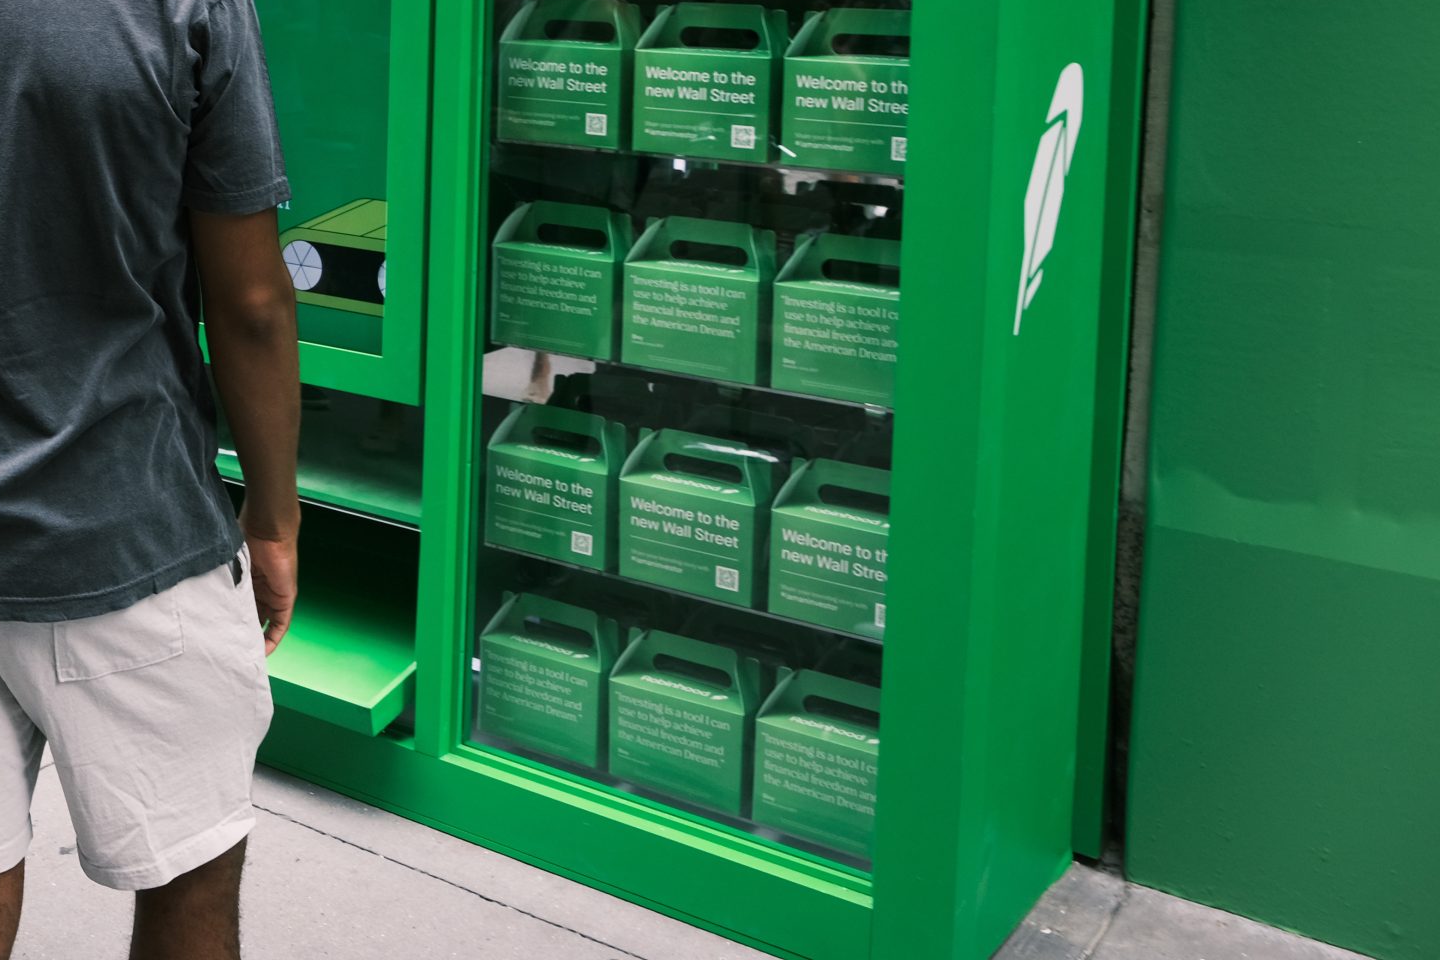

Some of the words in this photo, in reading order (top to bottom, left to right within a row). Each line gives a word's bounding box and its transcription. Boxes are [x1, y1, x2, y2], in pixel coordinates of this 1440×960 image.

[508, 56, 566, 73] Welcome
[569, 61, 583, 74] to
[585, 62, 608, 76] the
[645, 65, 710, 83] Welcome
[712, 70, 728, 84] to
[731, 72, 756, 86] the
[508, 77, 534, 88] new
[536, 76, 564, 90] Wall
[566, 78, 608, 93] Street
[796, 75, 868, 93] Welcome
[871, 80, 888, 94] to
[644, 87, 674, 98] new
[677, 86, 706, 101] Wall
[710, 88, 756, 104] Street
[796, 97, 828, 109] new
[832, 96, 864, 112] Wall
[680, 281, 688, 291] is
[698, 284, 720, 295] tool
[726, 289, 746, 298] can
[633, 291, 651, 300] use
[652, 291, 664, 301] to
[664, 293, 687, 307] help
[688, 297, 728, 310] achieve
[633, 301, 674, 315] financial
[676, 307, 718, 322] freedom
[720, 315, 740, 325] and
[633, 314, 648, 325] the
[650, 317, 698, 332] American
[496, 464, 552, 489] Welcome
[555, 478, 568, 493] to
[570, 482, 593, 499] the
[496, 483, 522, 498] new
[524, 487, 550, 505] Wall
[552, 494, 592, 515] Street
[630, 495, 694, 521] Welcome
[698, 510, 712, 525] to
[715, 514, 740, 531] the
[630, 516, 660, 531] new
[662, 520, 692, 538] Wall
[694, 527, 739, 549] Street
[782, 527, 852, 555] Welcome
[855, 543, 872, 560] to
[781, 549, 814, 566] new
[816, 553, 848, 573] Wall
